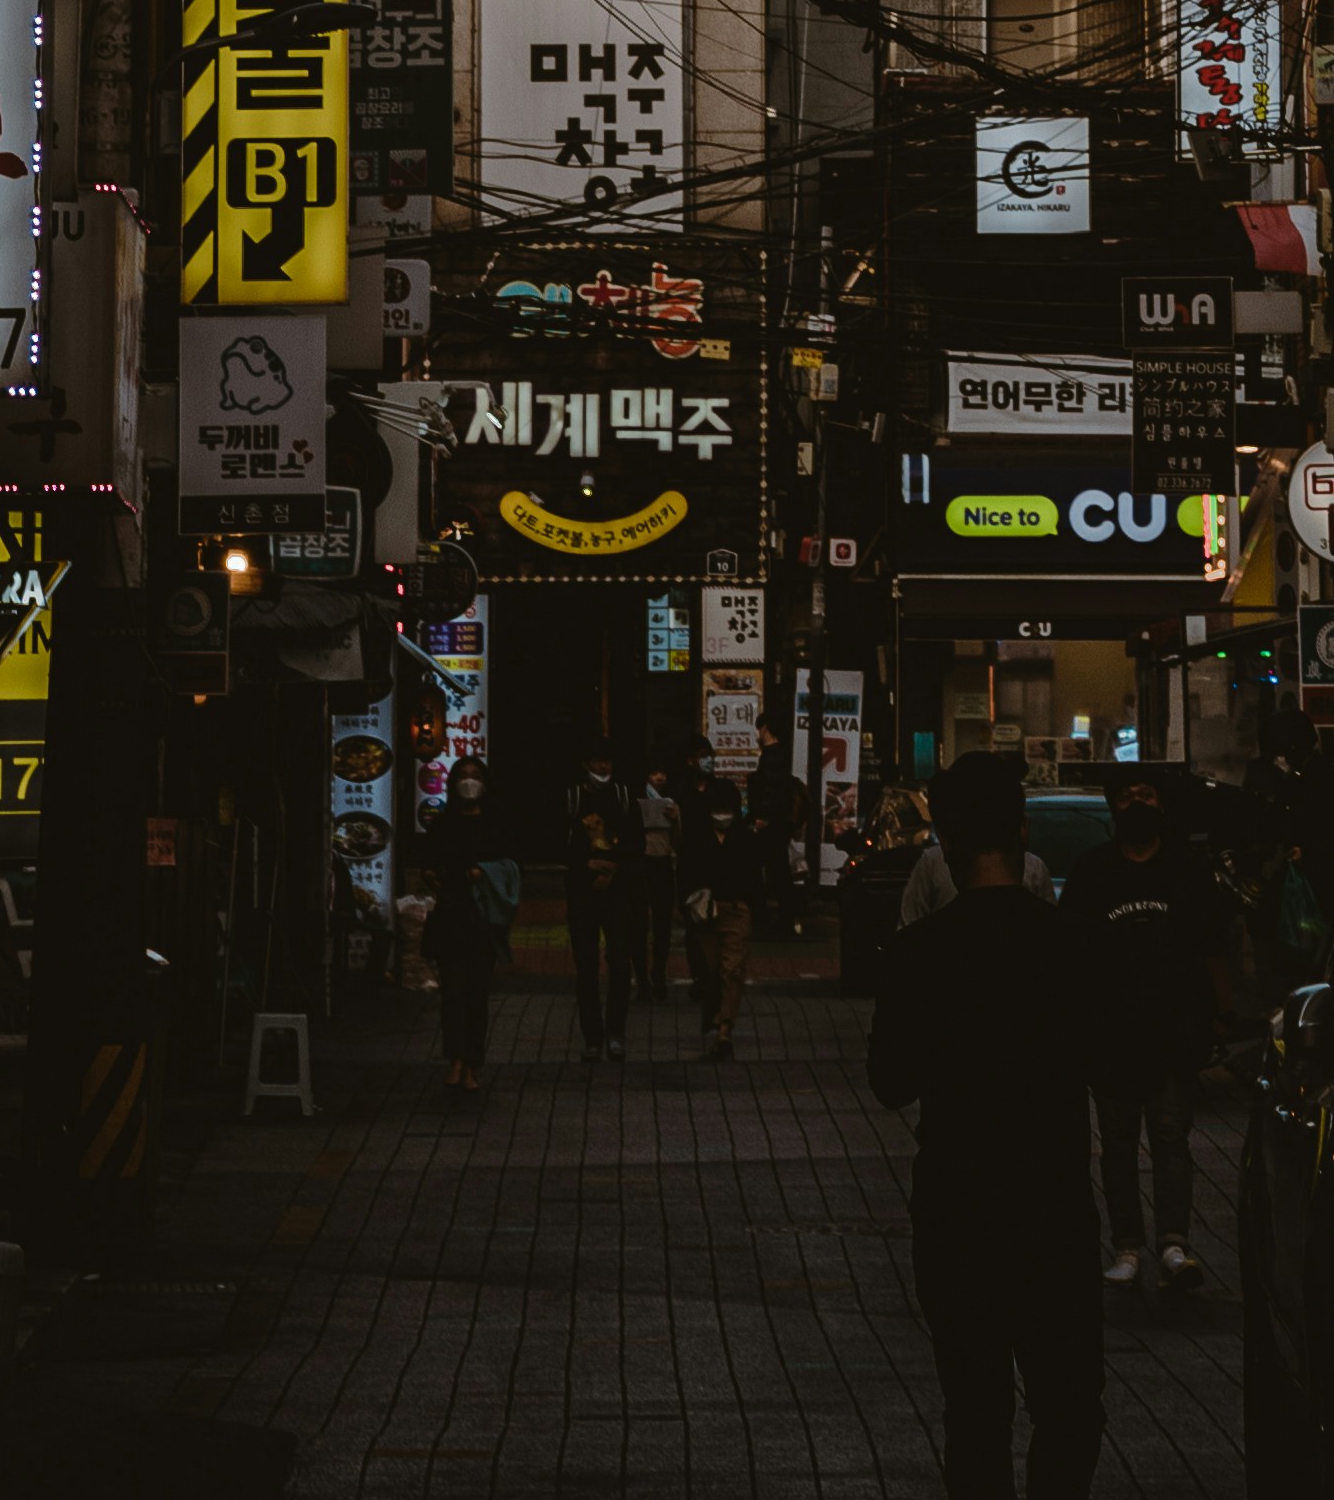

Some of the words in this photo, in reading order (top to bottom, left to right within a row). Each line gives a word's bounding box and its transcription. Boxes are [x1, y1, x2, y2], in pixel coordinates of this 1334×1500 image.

[530, 43, 666, 124] 맥주
[245, 140, 321, 204] B1
[1037, 202, 1072, 213] HIKARU
[1135, 360, 1182, 375] SIMPLE
[1186, 361, 1232, 375] HOUSE
[958, 378, 1087, 414] 연어무한
[1097, 382, 1135, 414] 리
[1136, 378, 1231, 394] シンプルハウス
[463, 380, 734, 462] 세계맥주
[198, 425, 281, 451] 두꺼비
[217, 502, 291, 525] 신촌점
[963, 507, 1013, 527] Nice
[1017, 507, 1041, 527] to
[1067, 488, 1169, 544] CU
[715, 561, 731, 573] 10
[710, 702, 755, 726] 임대
[796, 716, 860, 733] IZKAYA
